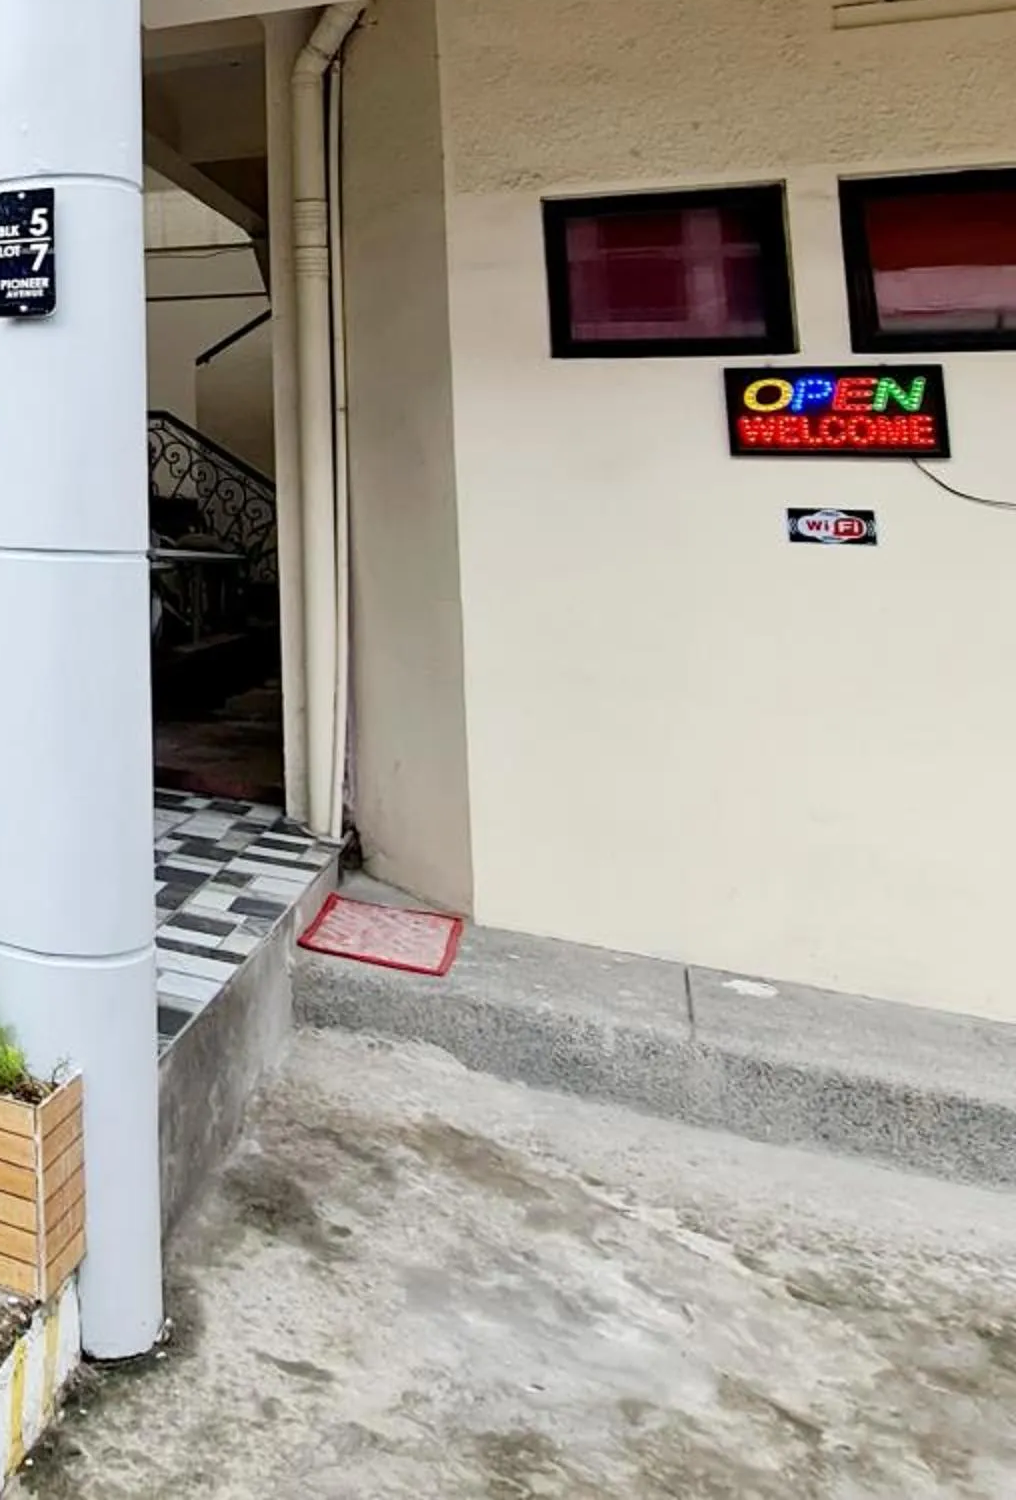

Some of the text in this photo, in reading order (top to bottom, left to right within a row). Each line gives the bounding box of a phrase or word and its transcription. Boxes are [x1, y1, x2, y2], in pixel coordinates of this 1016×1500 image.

[29, 207, 49, 236] 5
[29, 243, 50, 272] 7
[0, 277, 50, 290] PIONEER
[5, 289, 44, 299] AVENUE
[743, 375, 927, 412] OPEN
[738, 415, 935, 445] WELCOME
